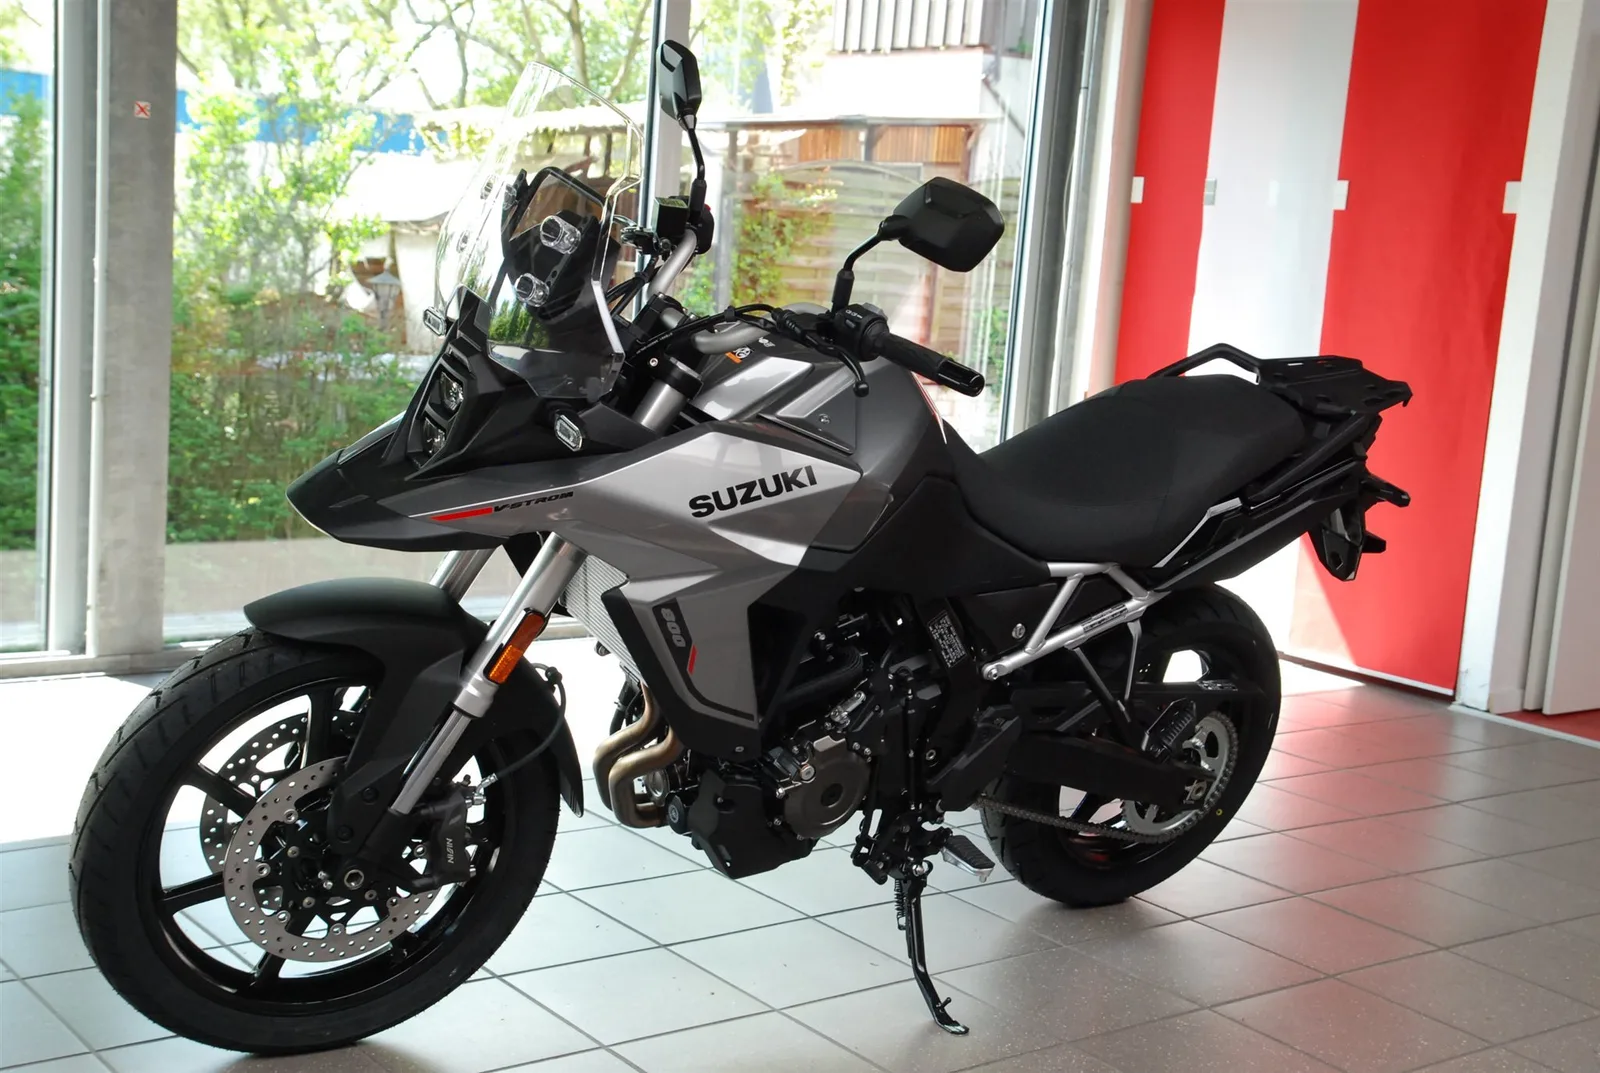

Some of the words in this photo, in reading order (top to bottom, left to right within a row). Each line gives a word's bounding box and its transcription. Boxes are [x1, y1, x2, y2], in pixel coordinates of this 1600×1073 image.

[494, 491, 574, 512] V-STROM
[689, 465, 817, 518] SUZUKI
[661, 608, 686, 647] 800
